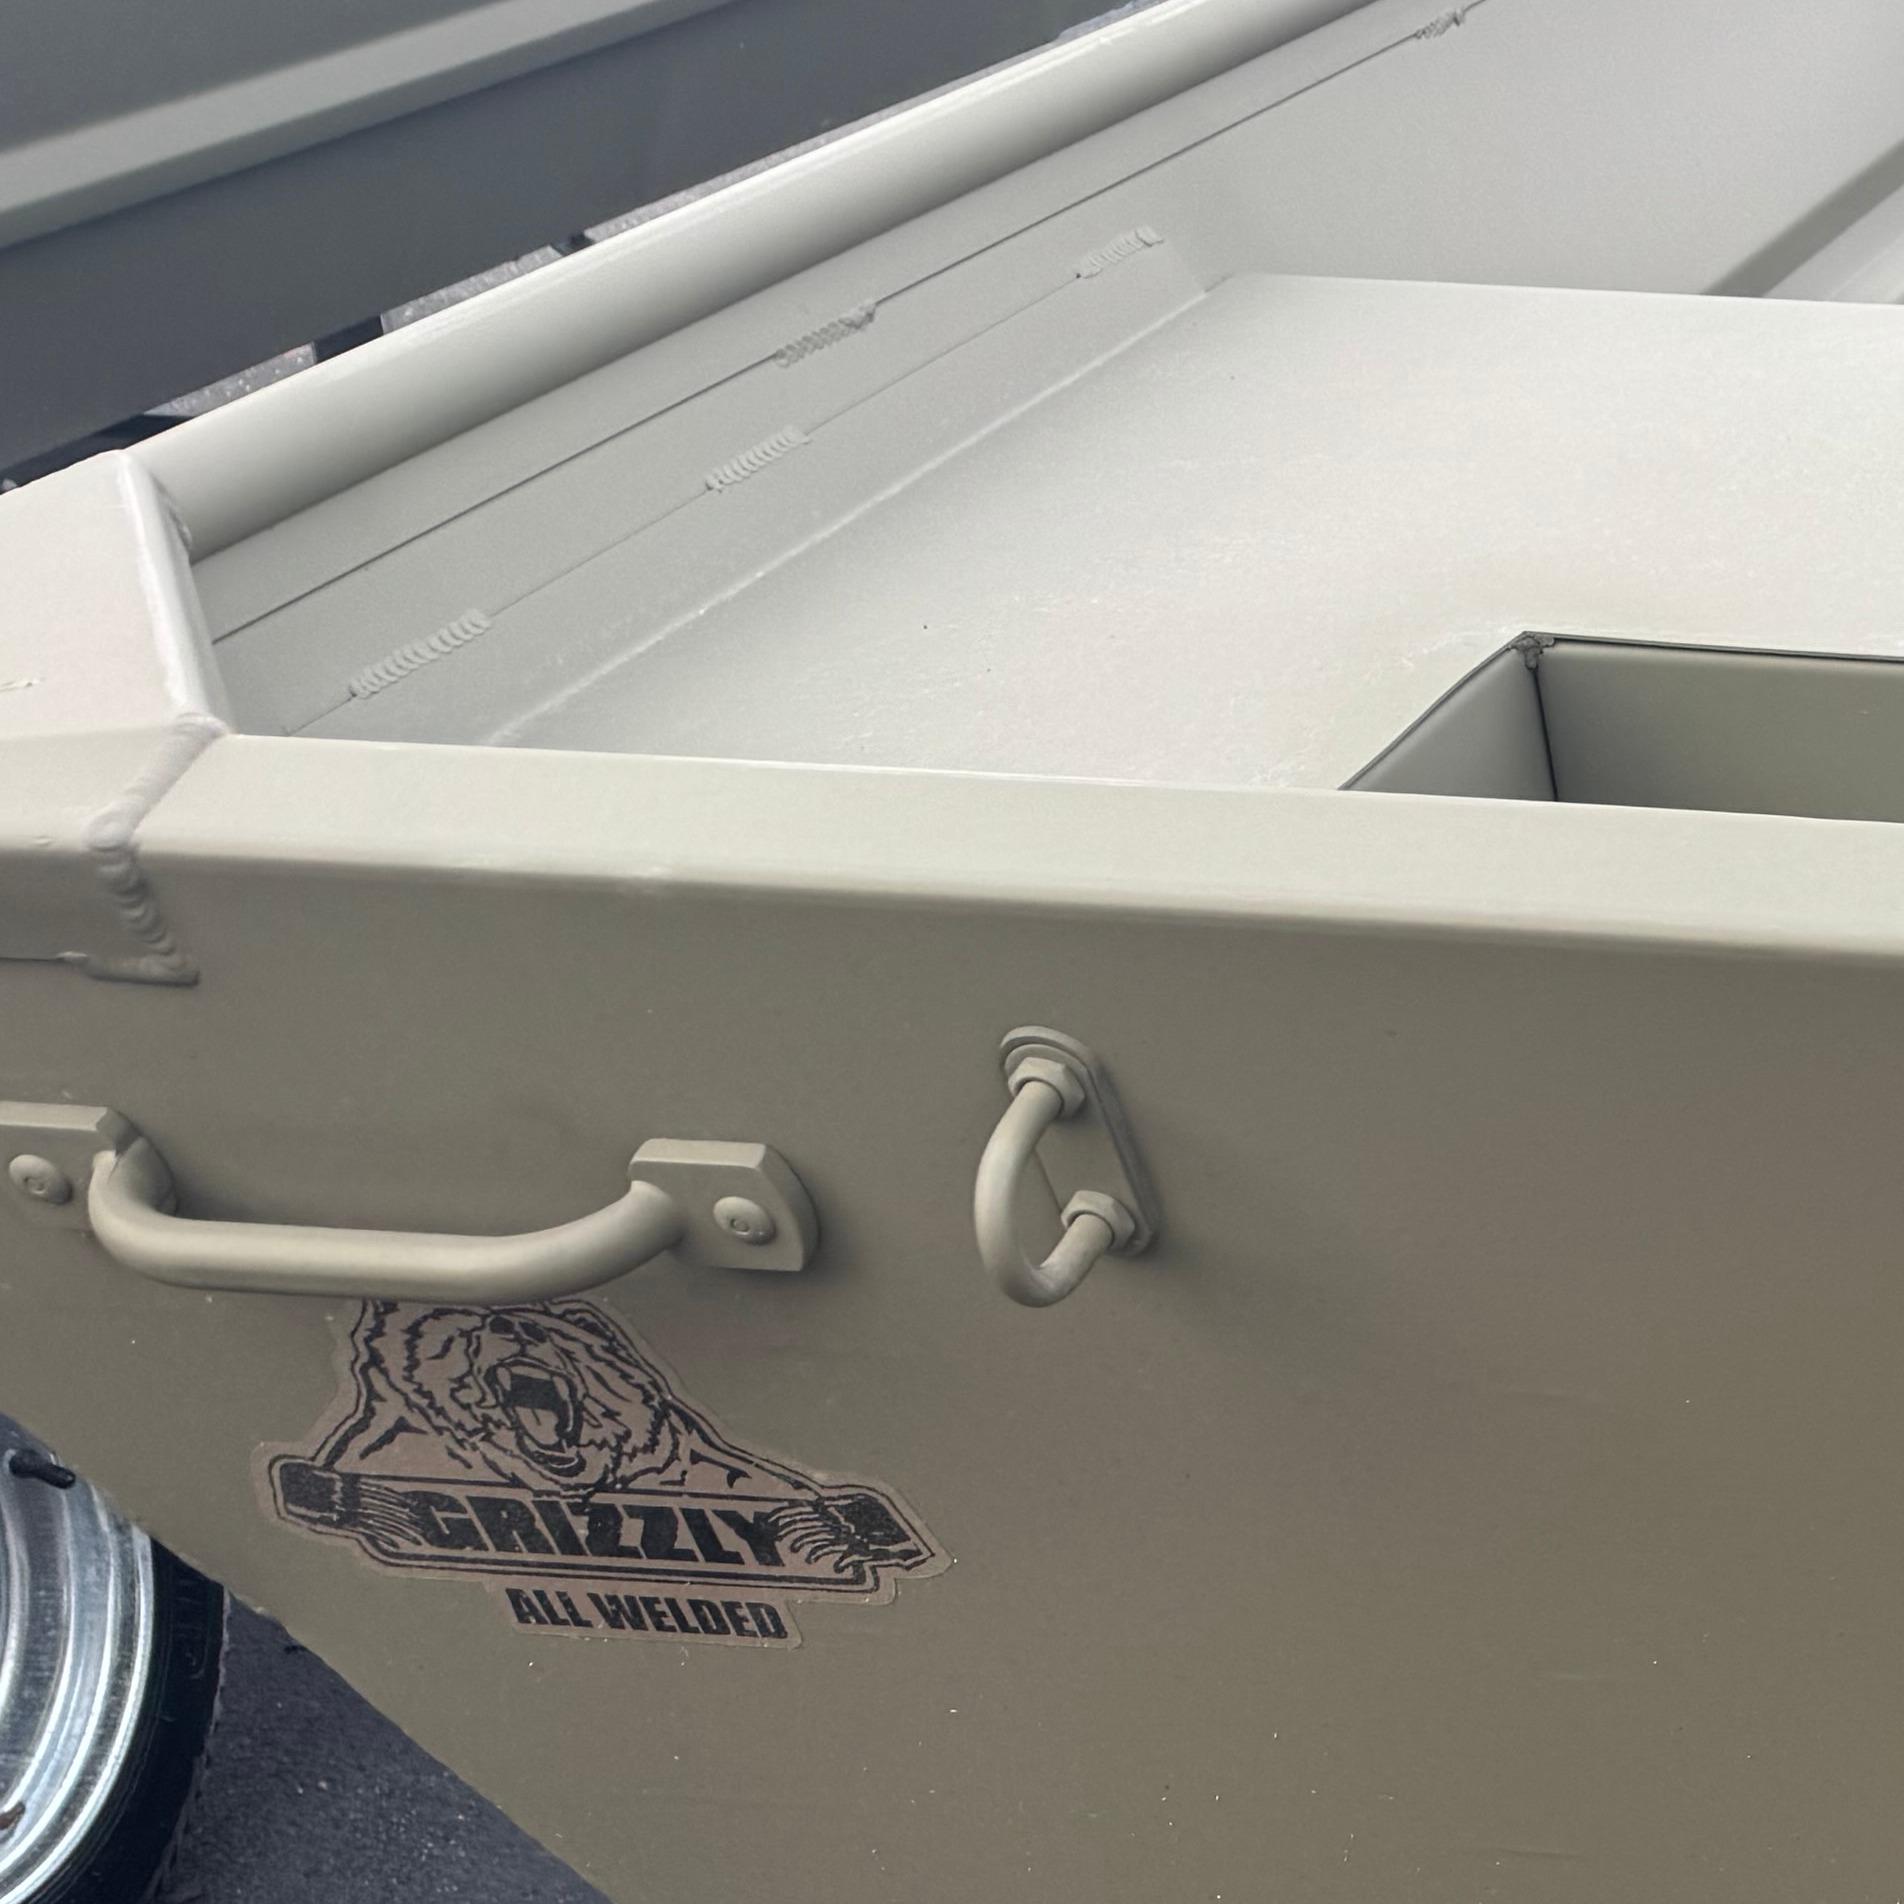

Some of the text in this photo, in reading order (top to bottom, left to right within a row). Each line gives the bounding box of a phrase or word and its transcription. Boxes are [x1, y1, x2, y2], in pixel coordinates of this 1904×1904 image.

[399, 1490, 787, 1567] GRIZZLY
[504, 1587, 790, 1640] ALL WELDED
